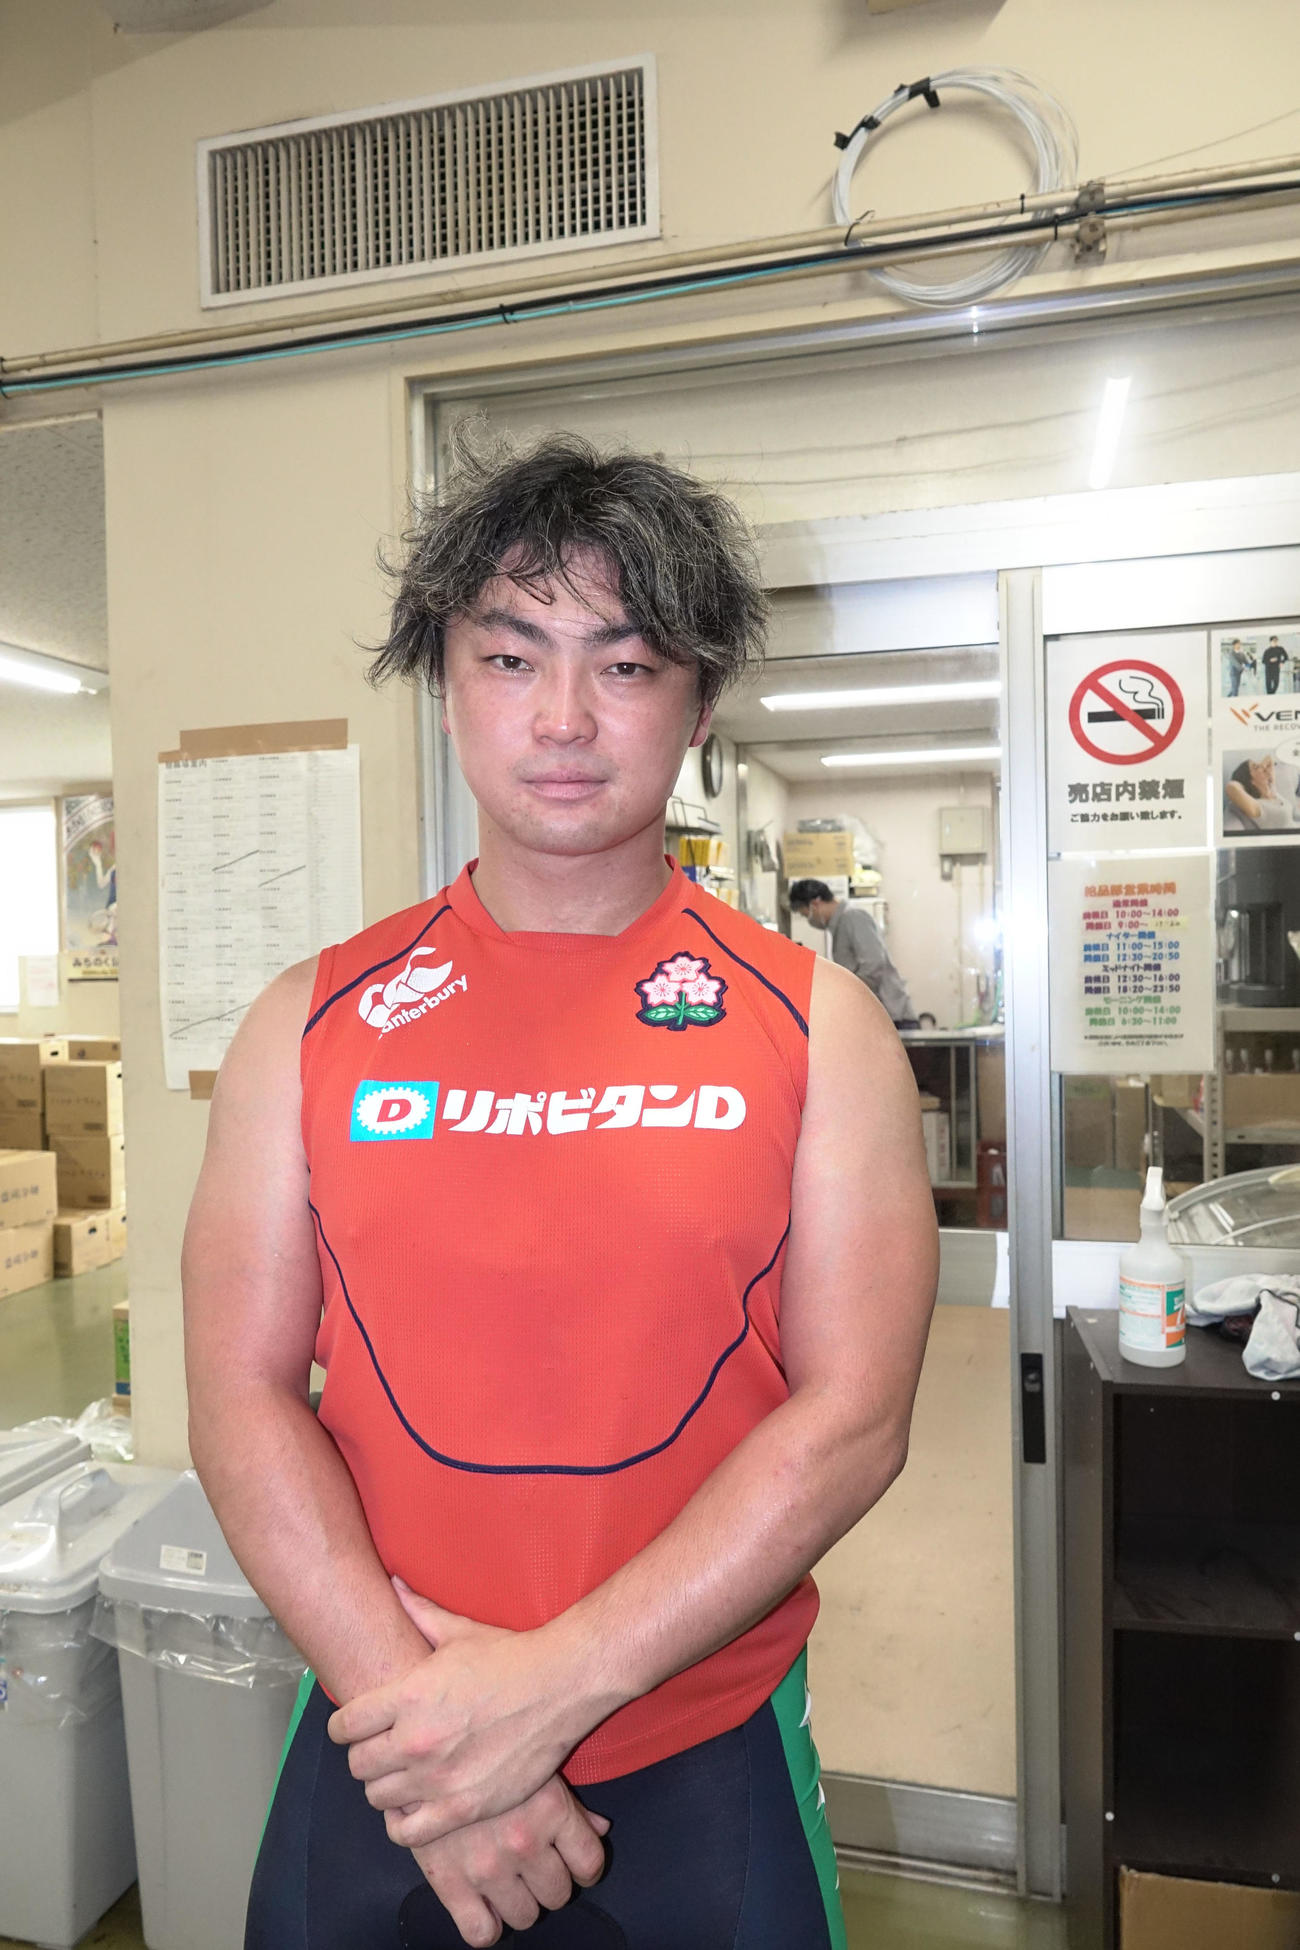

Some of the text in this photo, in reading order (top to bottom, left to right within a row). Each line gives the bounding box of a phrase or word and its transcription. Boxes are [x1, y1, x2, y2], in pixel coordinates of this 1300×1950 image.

[1254, 724, 1270, 732] THE
[1068, 779, 1185, 804] 売店内禁煙
[1070, 810, 1182, 823] ご協力をお願い致します。
[442, 1084, 747, 1136] リポビタンD
